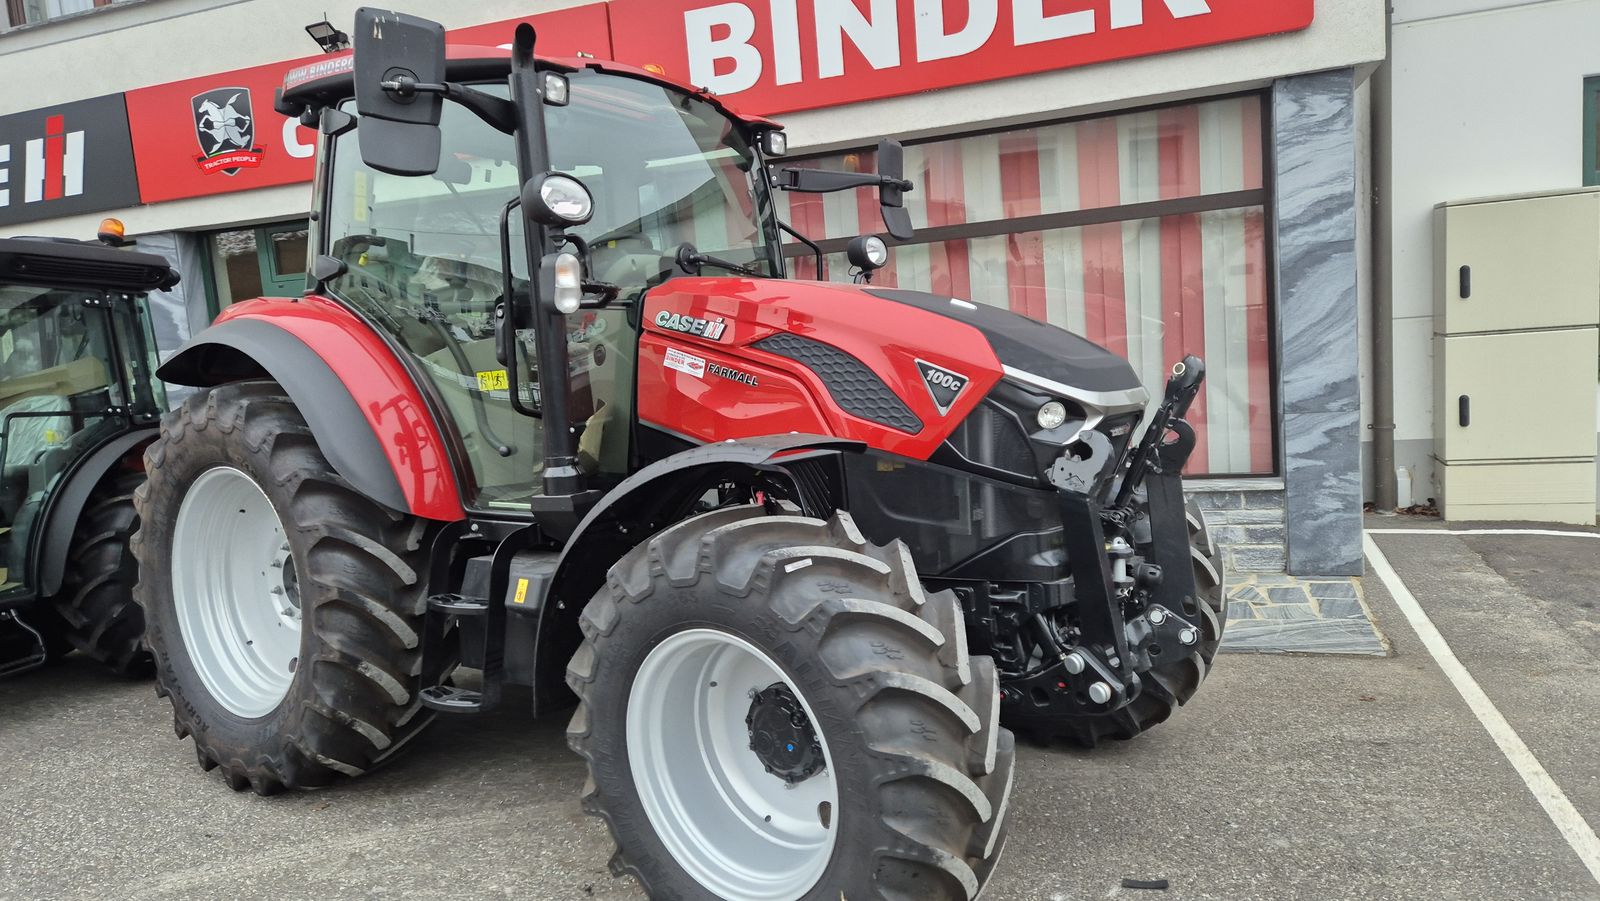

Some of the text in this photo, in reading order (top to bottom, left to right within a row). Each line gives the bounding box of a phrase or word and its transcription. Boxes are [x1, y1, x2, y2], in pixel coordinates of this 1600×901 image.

[204, 157, 232, 169] TRACTOR
[655, 310, 706, 335] CASE
[706, 363, 759, 387] FARMALL
